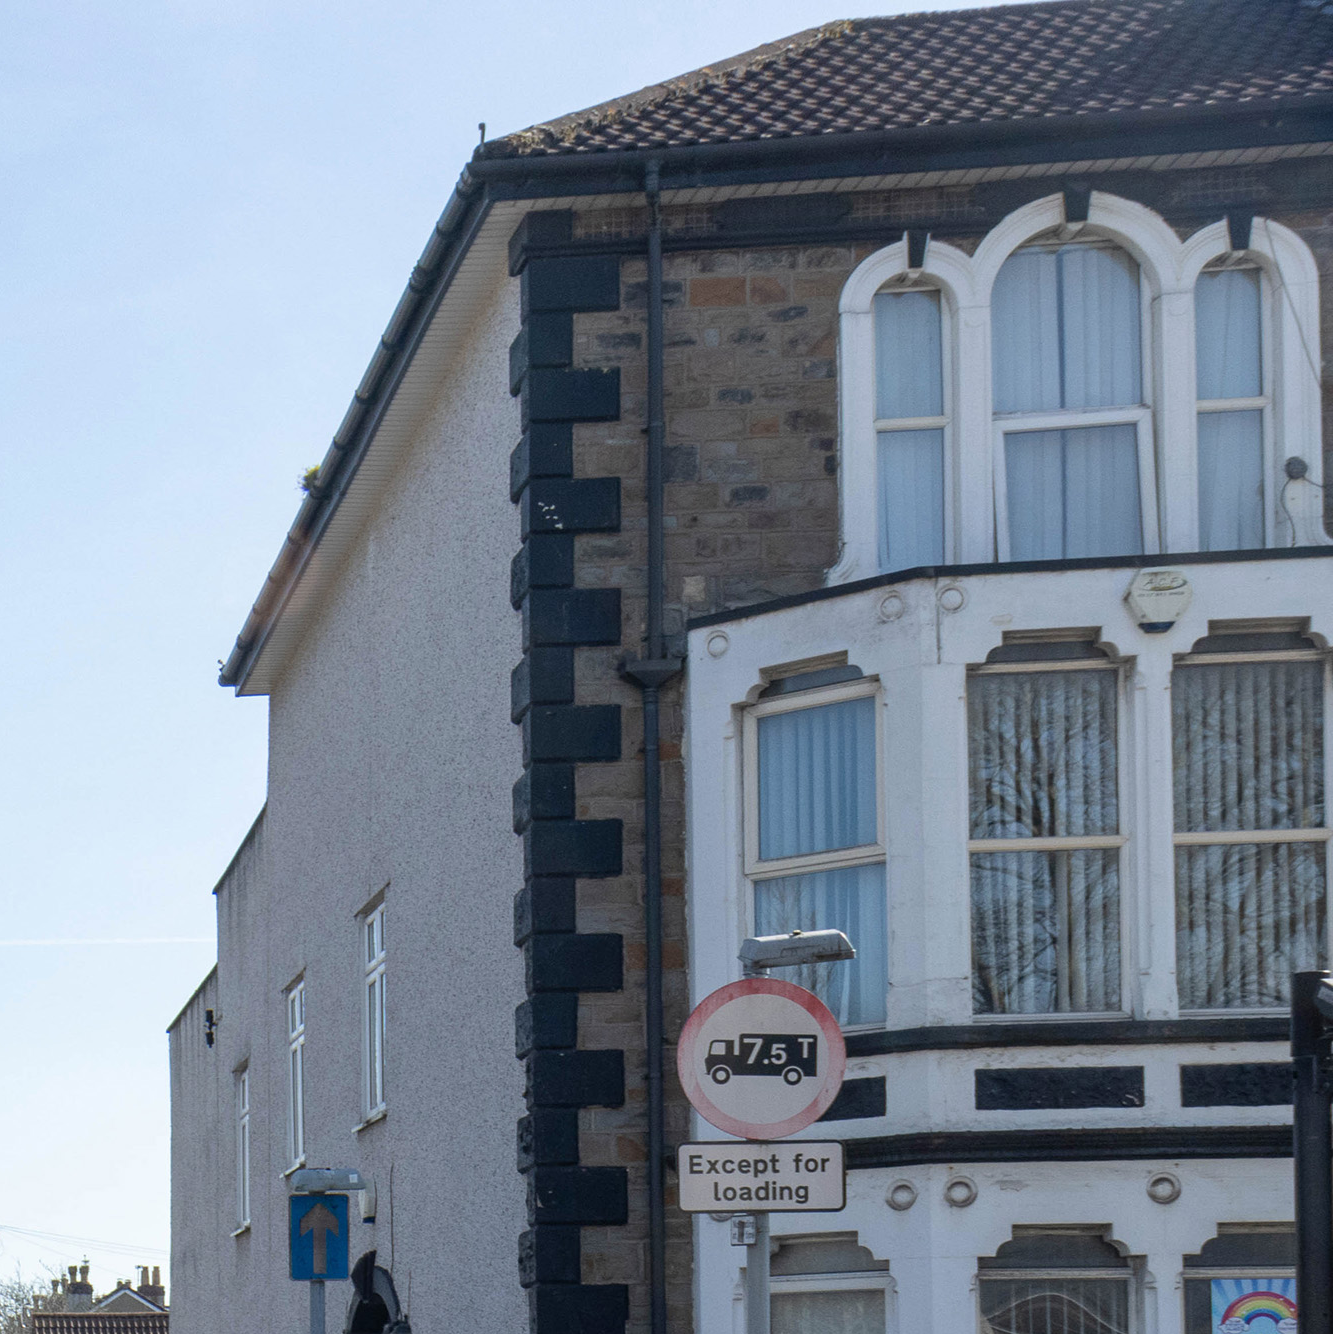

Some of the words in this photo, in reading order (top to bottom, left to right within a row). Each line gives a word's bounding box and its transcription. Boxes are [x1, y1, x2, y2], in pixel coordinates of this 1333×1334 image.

[688, 1153, 780, 1178] Except
[793, 1153, 831, 1173] for
[714, 1181, 810, 1204] loading
